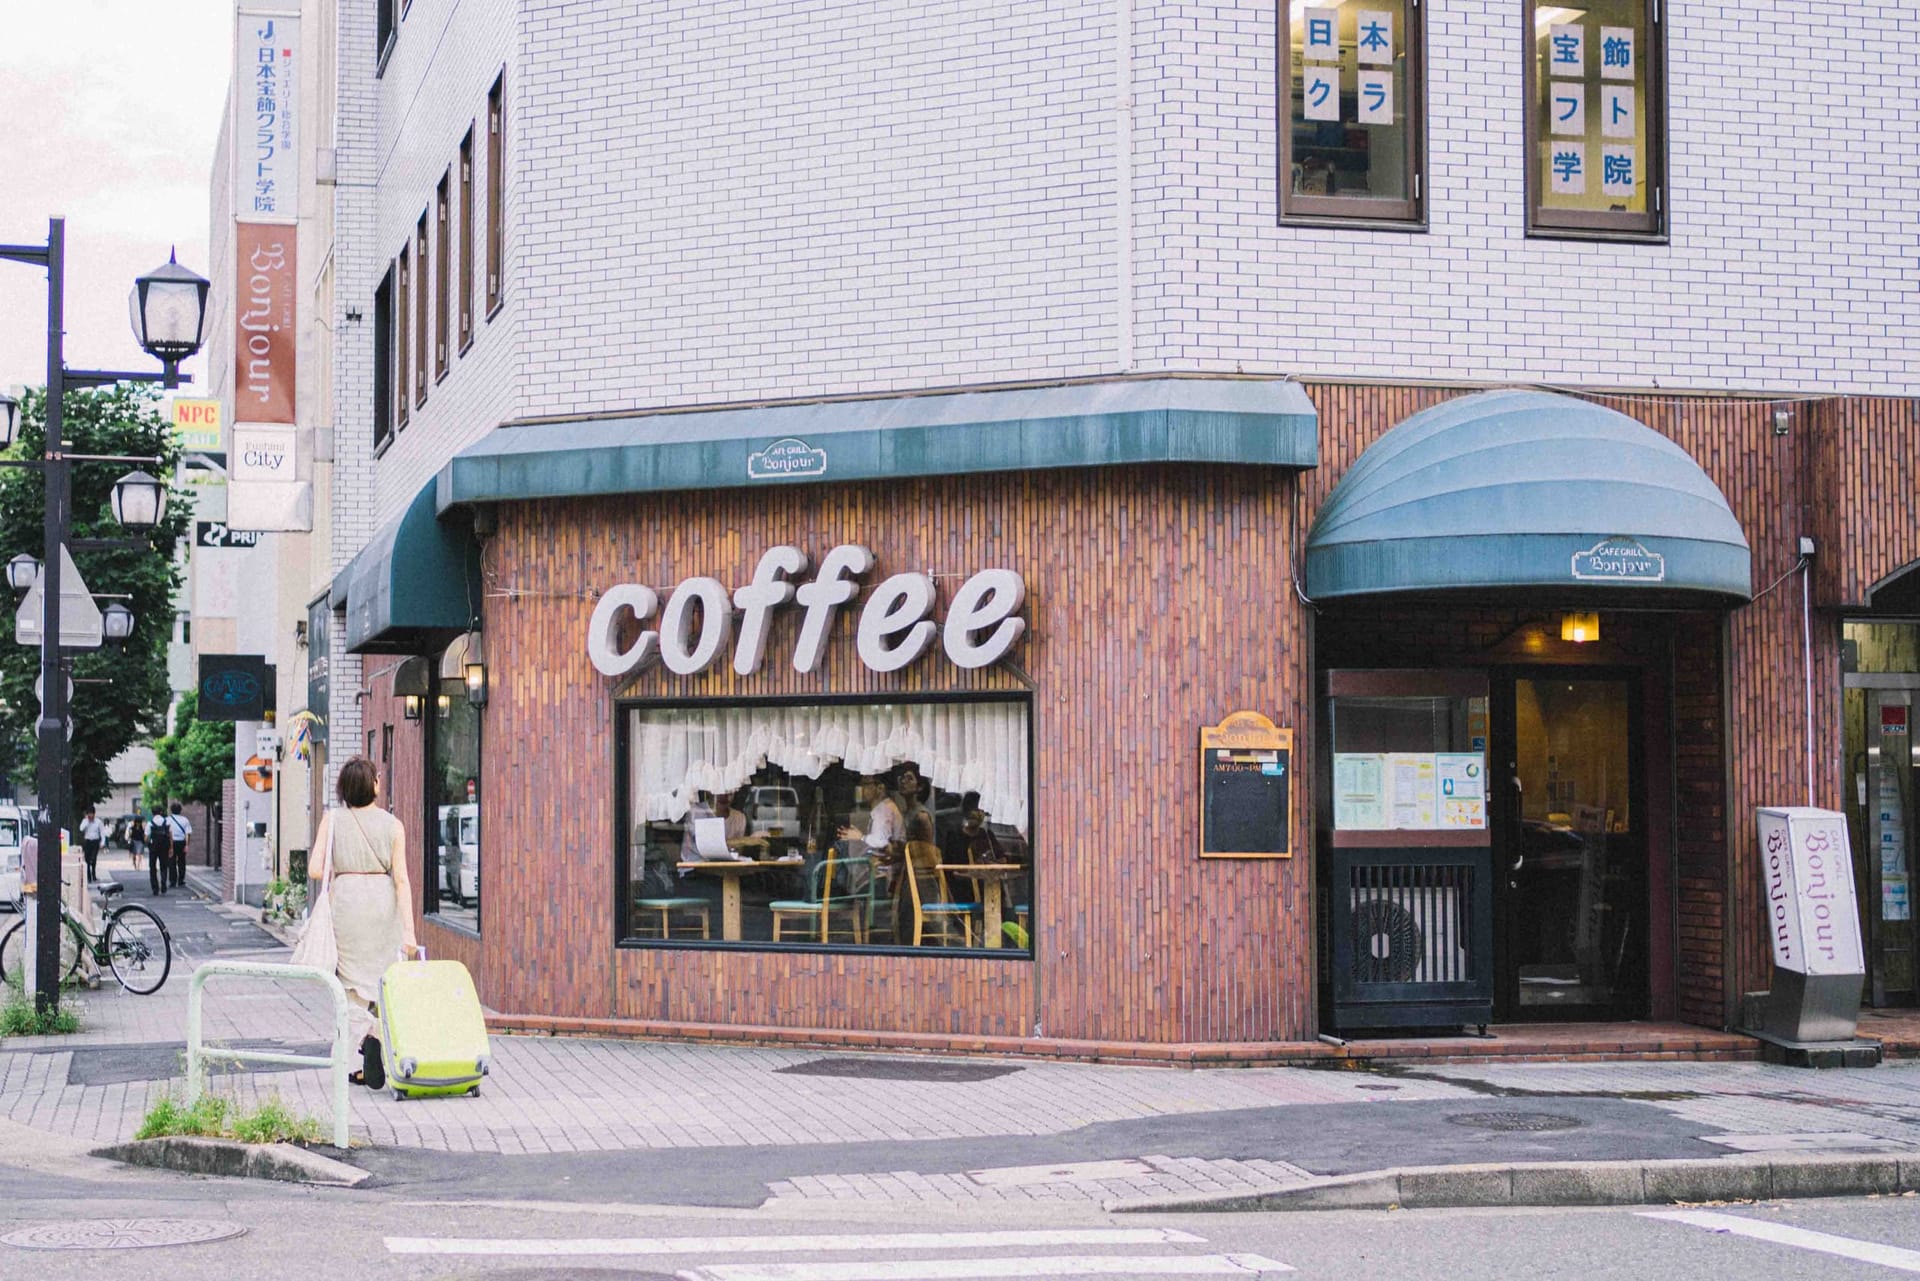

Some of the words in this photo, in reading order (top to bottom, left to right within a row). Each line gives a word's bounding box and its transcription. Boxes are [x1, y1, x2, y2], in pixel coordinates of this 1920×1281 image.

[254, 48, 276, 212] 日本宝飾クラフト学院
[1553, 152, 1632, 184] 学院
[240, 243, 285, 402] Bonjour
[178, 405, 215, 423] NPC
[244, 451, 284, 470] City
[762, 455, 814, 472] Bonjour
[1589, 556, 1651, 575] Bonjour
[1599, 547, 1619, 556] CAFE
[1621, 547, 1642, 556] GRILL
[588, 545, 1026, 676] coffee
[1767, 829, 1791, 960] Bonjour
[1805, 830, 1836, 960] Bonjour
